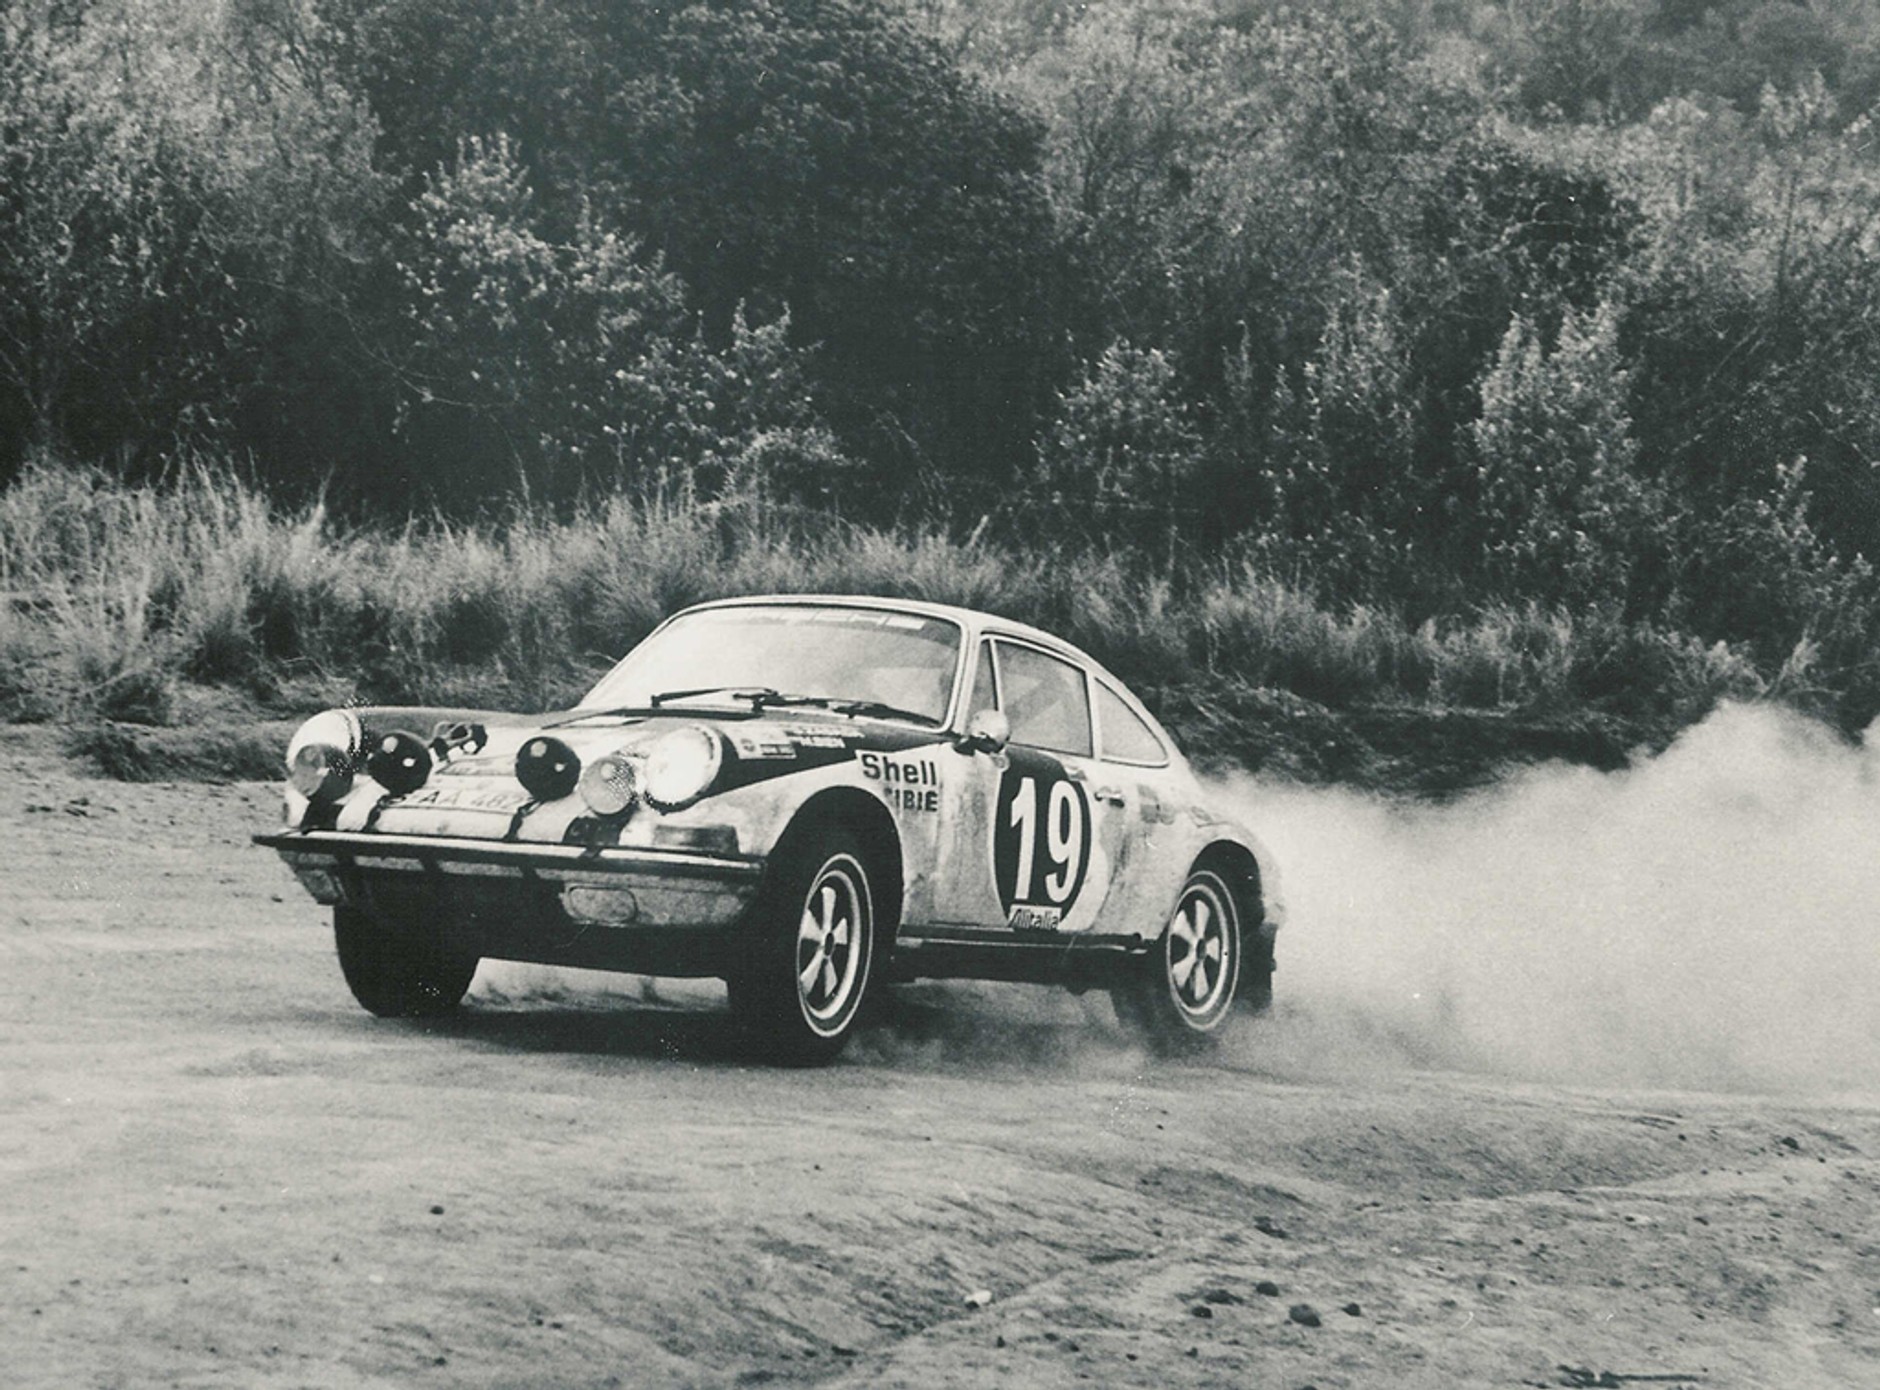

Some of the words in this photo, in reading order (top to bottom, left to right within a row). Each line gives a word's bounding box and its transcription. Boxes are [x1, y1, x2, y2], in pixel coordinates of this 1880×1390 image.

[861, 753, 937, 786] Shell
[1010, 776, 1082, 903] 19
[1008, 908, 1060, 931] Alitalia
